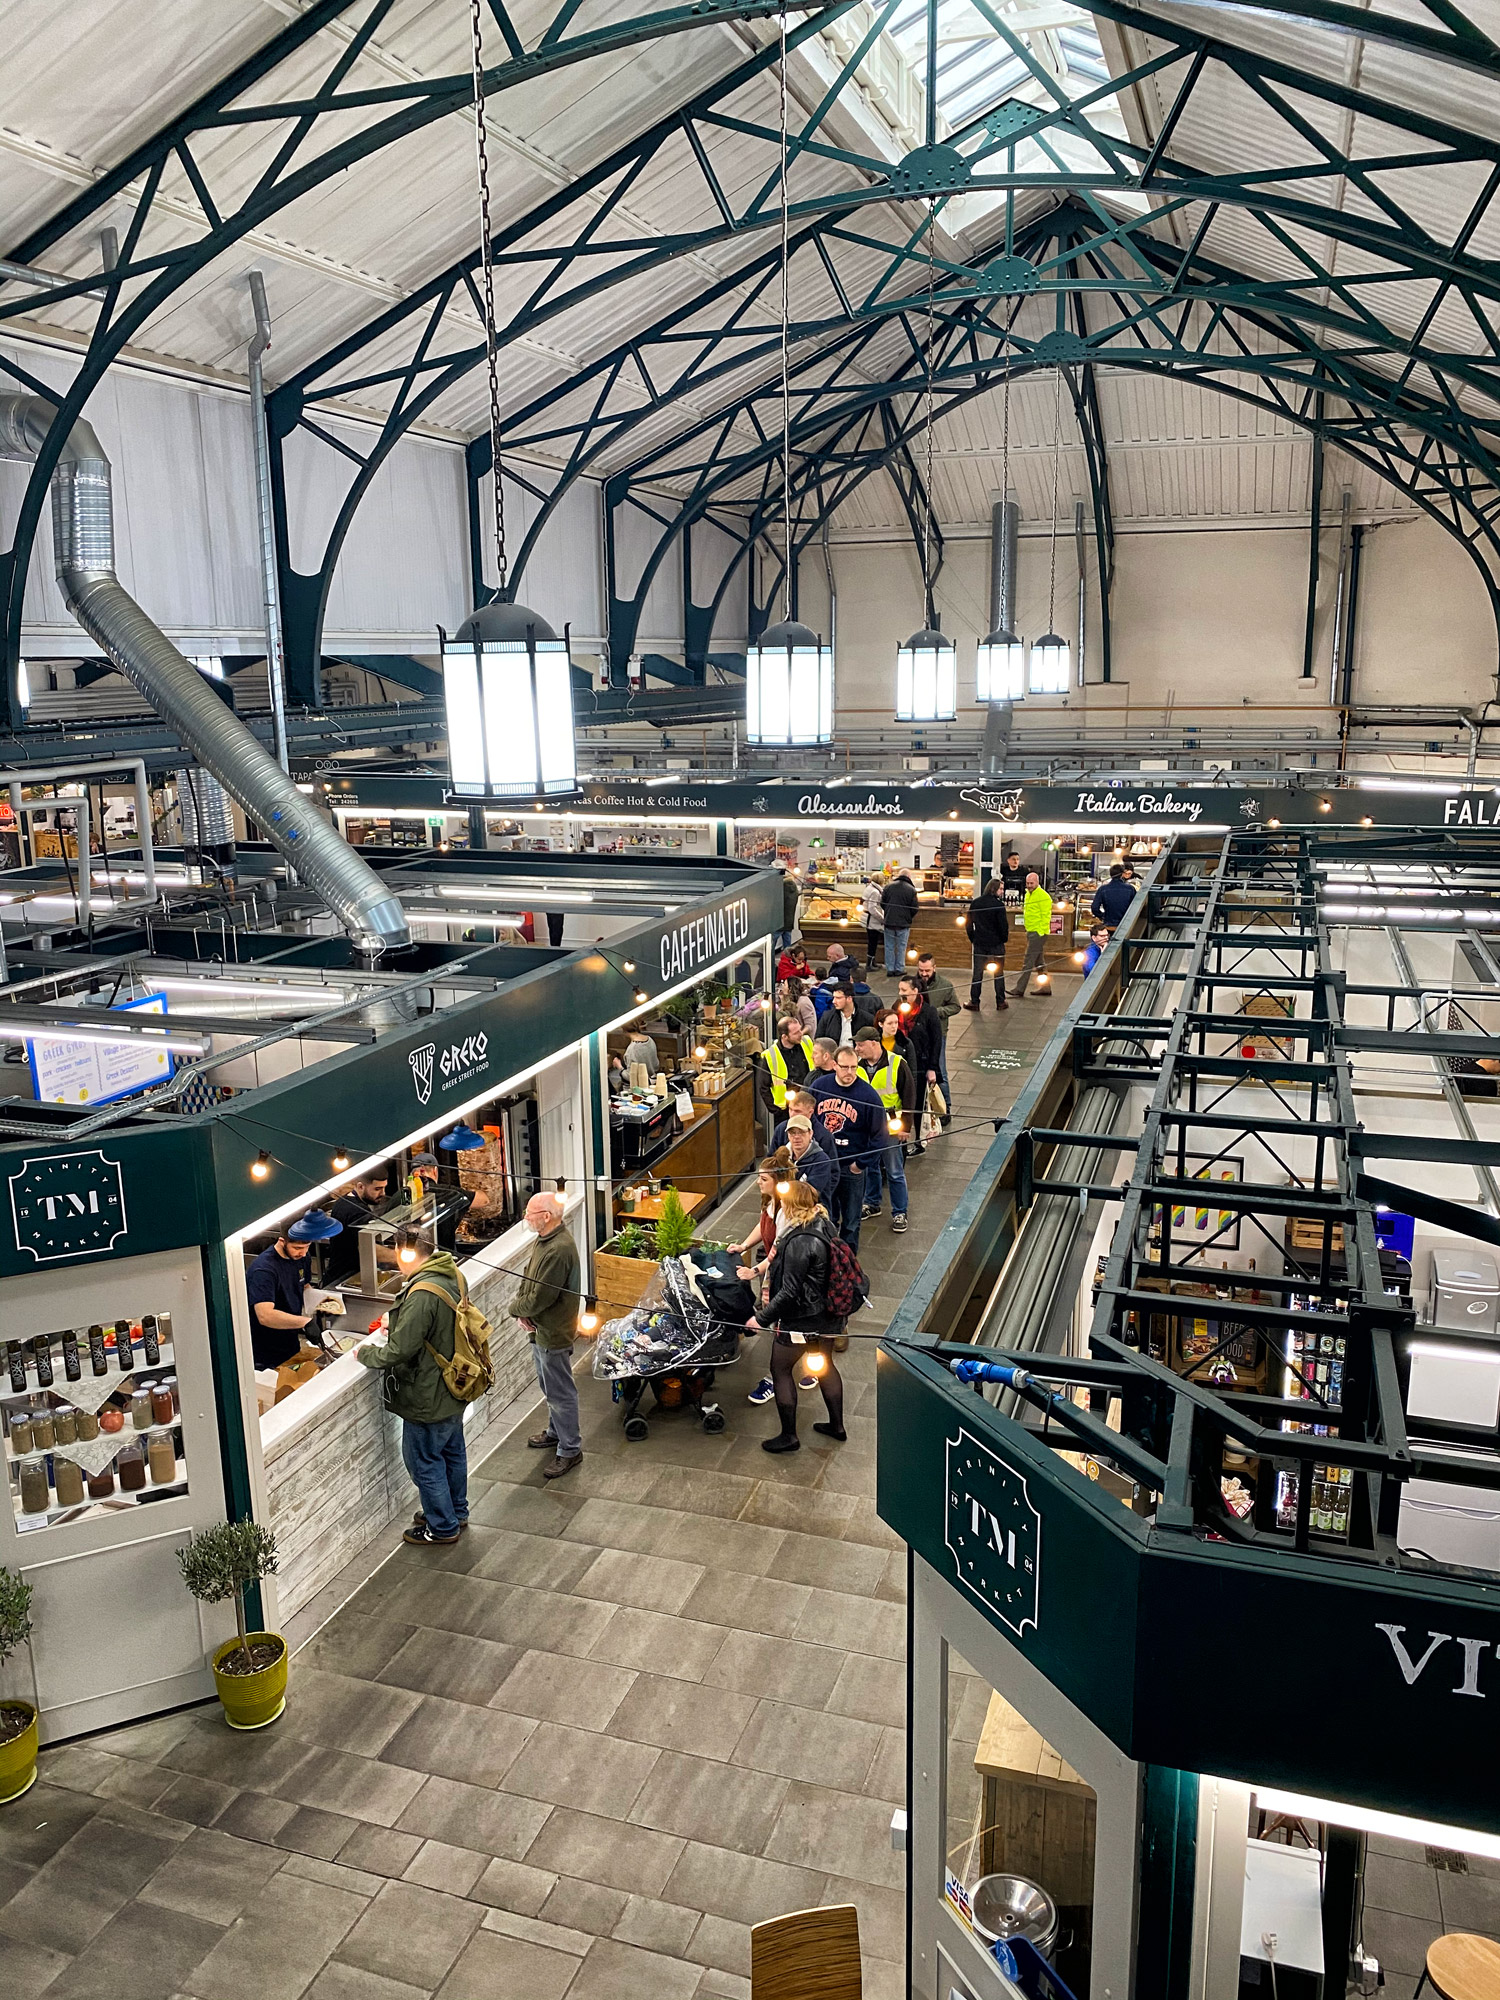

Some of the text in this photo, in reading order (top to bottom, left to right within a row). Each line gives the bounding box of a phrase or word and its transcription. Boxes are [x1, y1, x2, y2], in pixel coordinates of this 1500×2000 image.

[594, 795, 625, 806] Coffee
[627, 796, 644, 806] Hot
[646, 796, 656, 806] &
[657, 796, 681, 807] Cold
[683, 797, 707, 808] Food
[798, 793, 904, 815] Alessandro's
[979, 795, 1018, 805] SICILY
[1074, 792, 1203, 822] Italian Bakery
[660, 897, 748, 982] CAFFEINATED
[439, 1030, 488, 1077] GREKO
[441, 1061, 490, 1091] GREEK STREET FOOD
[817, 1098, 858, 1123] CHICAGO
[24, 1163, 109, 1193] TRINITY
[36, 1190, 100, 1220] TM
[32, 1219, 110, 1248] MARKET
[957, 1459, 1028, 1532] TRINITY
[965, 1492, 1016, 1569] TM
[957, 1536, 1023, 1603] MARKET
[1374, 1622, 1500, 1698] VI
[951, 1874, 969, 1904] VISA
